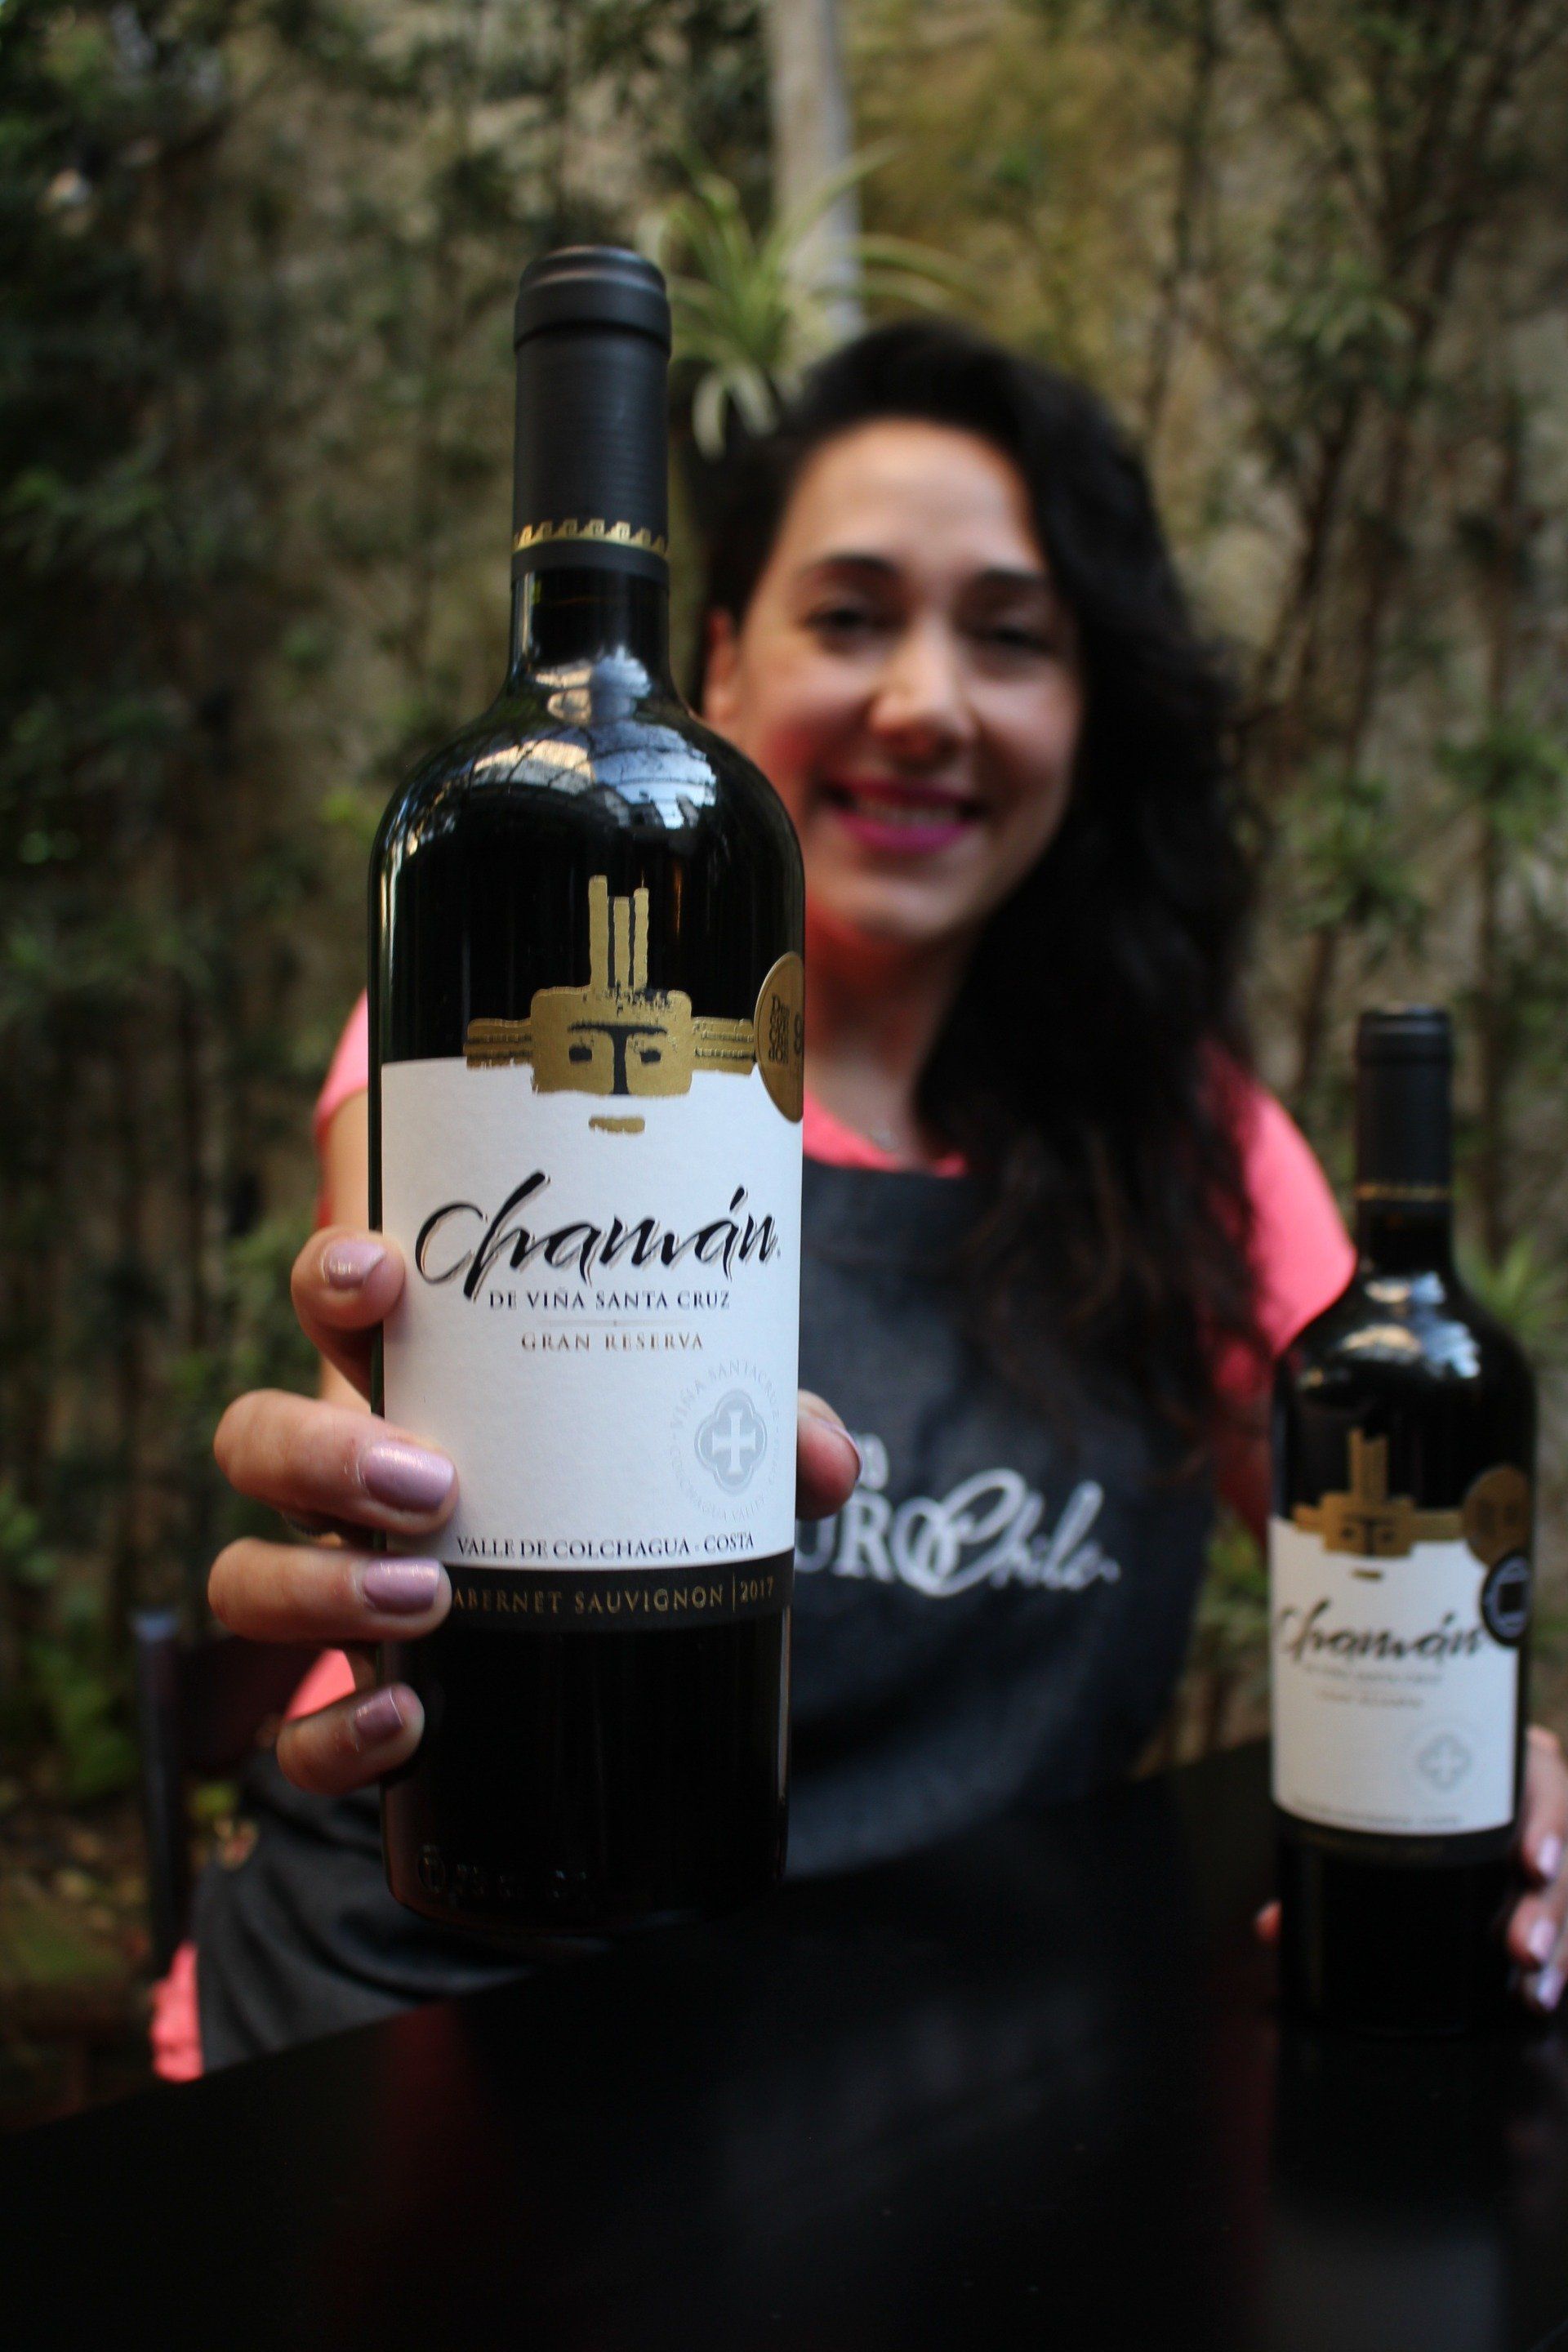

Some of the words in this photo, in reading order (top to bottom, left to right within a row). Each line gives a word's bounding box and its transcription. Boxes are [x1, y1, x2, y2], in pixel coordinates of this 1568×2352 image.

[415, 1169, 777, 1300] Chamán
[490, 1291, 516, 1309] DE
[527, 1287, 585, 1310] VIÑA
[595, 1291, 668, 1310] SANTA
[677, 1291, 730, 1310] CRUZ
[520, 1333, 590, 1352] GRAN
[604, 1333, 704, 1352] RESERVA
[457, 1537, 514, 1558] VALLE
[520, 1539, 546, 1559] DE
[552, 1537, 690, 1561] COLCHAGUA
[703, 1532, 755, 1555] COSTA
[454, 1587, 564, 1615] ABERNET
[574, 1584, 724, 1615] SAUVIGNON
[739, 1575, 775, 1604] 2017
